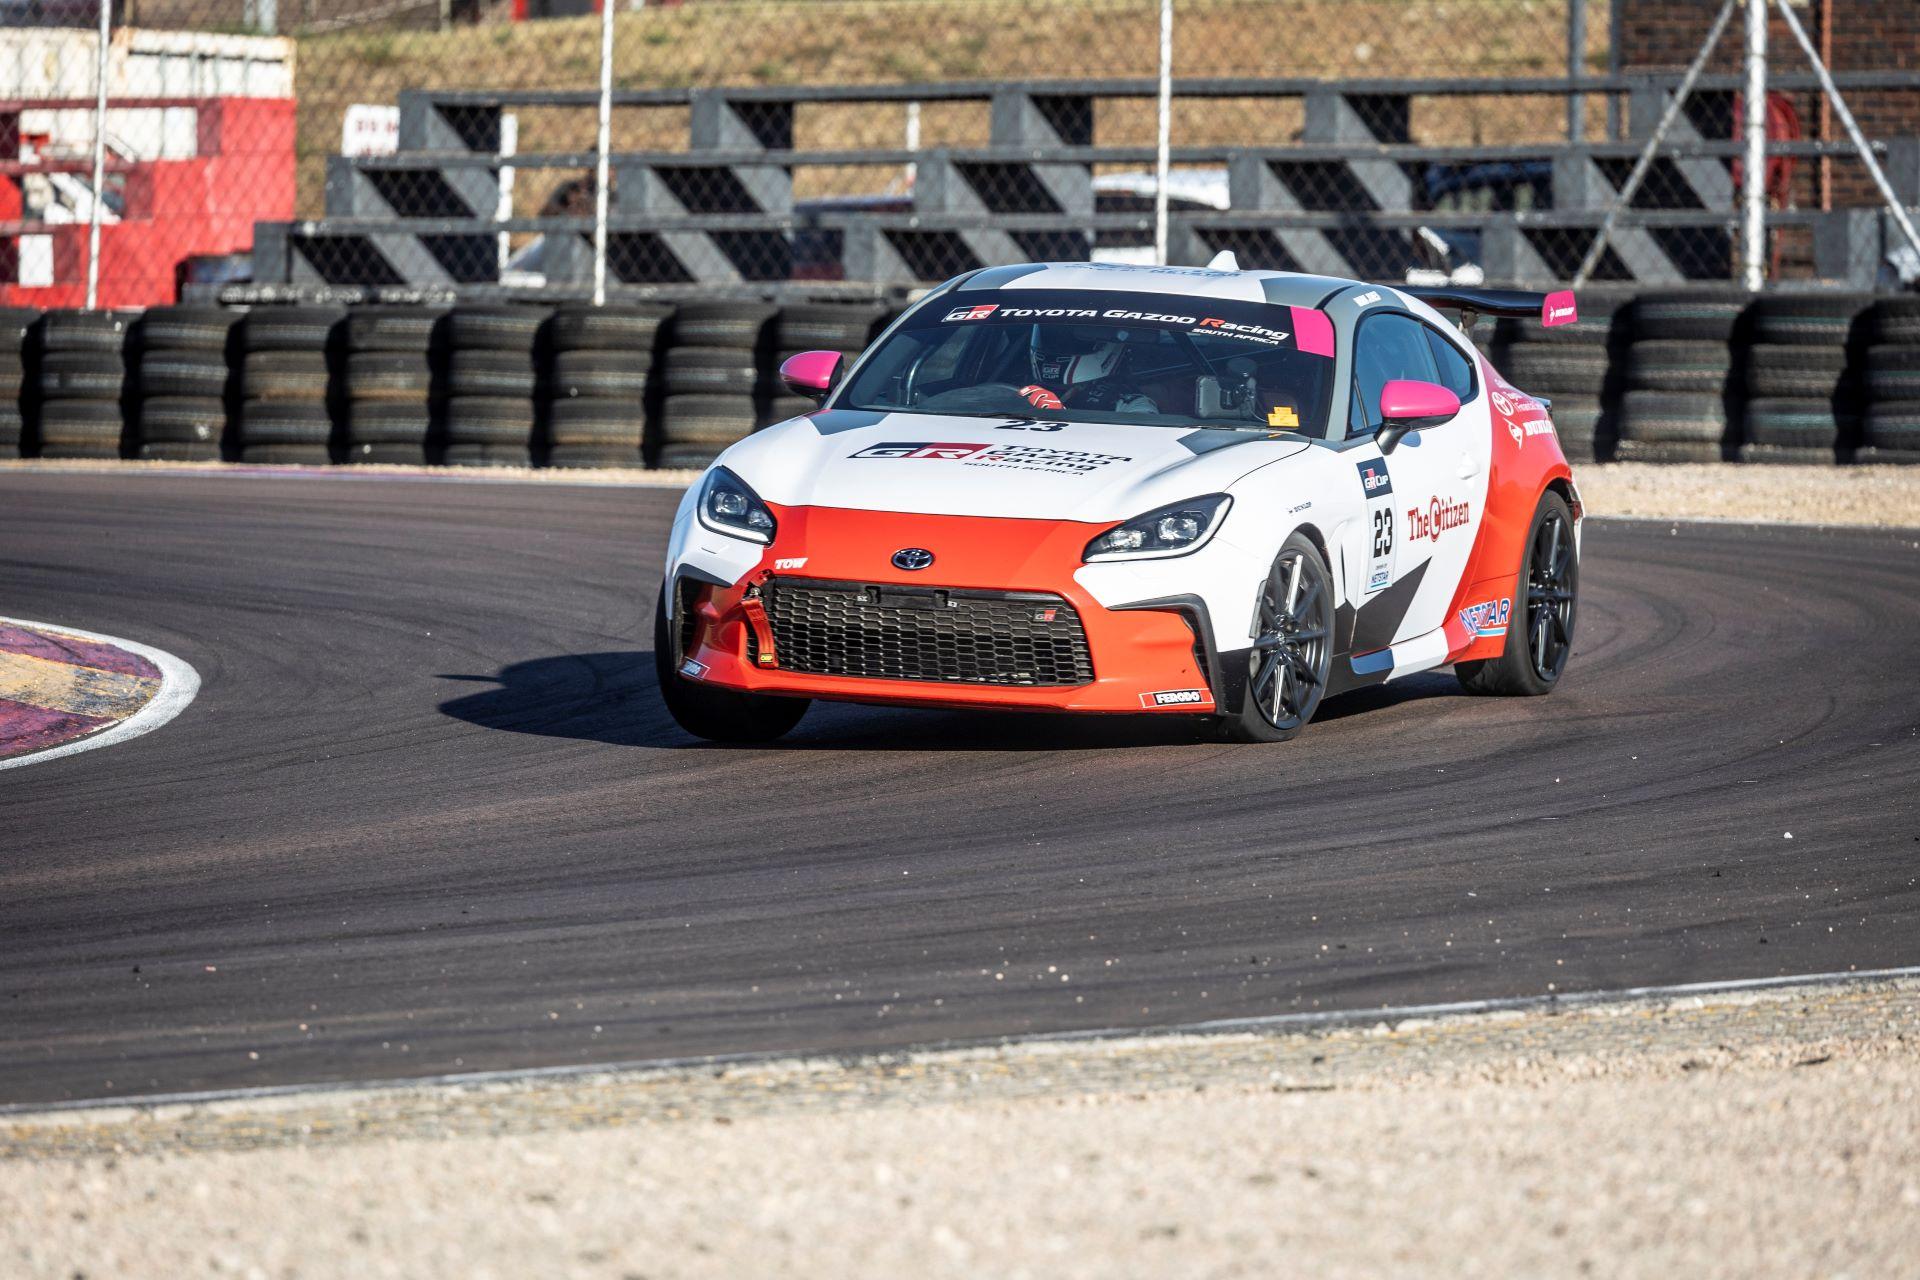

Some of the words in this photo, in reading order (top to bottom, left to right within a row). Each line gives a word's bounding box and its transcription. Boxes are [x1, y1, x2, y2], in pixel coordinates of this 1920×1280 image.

[946, 308, 990, 322] GR
[1000, 308, 1098, 318] TOYOTA
[1103, 309, 1197, 324] GAZOO
[1199, 316, 1290, 341] Racing
[1191, 328, 1233, 338] SOUTH
[1234, 333, 1280, 346] AFRICA
[995, 419, 1070, 433] 23
[850, 447, 984, 460] GR
[984, 450, 1112, 465] GAZOO
[1002, 444, 1133, 462] TOYOTA
[963, 461, 1021, 470] SOUTH
[1023, 465, 1085, 476] AFRICA
[973, 454, 1098, 472] Racing
[1407, 506, 1429, 541] The
[1429, 495, 1470, 543] Citizen
[1373, 507, 1393, 558] 23
[775, 557, 809, 570] TOW
[1155, 691, 1201, 704] FERODO
